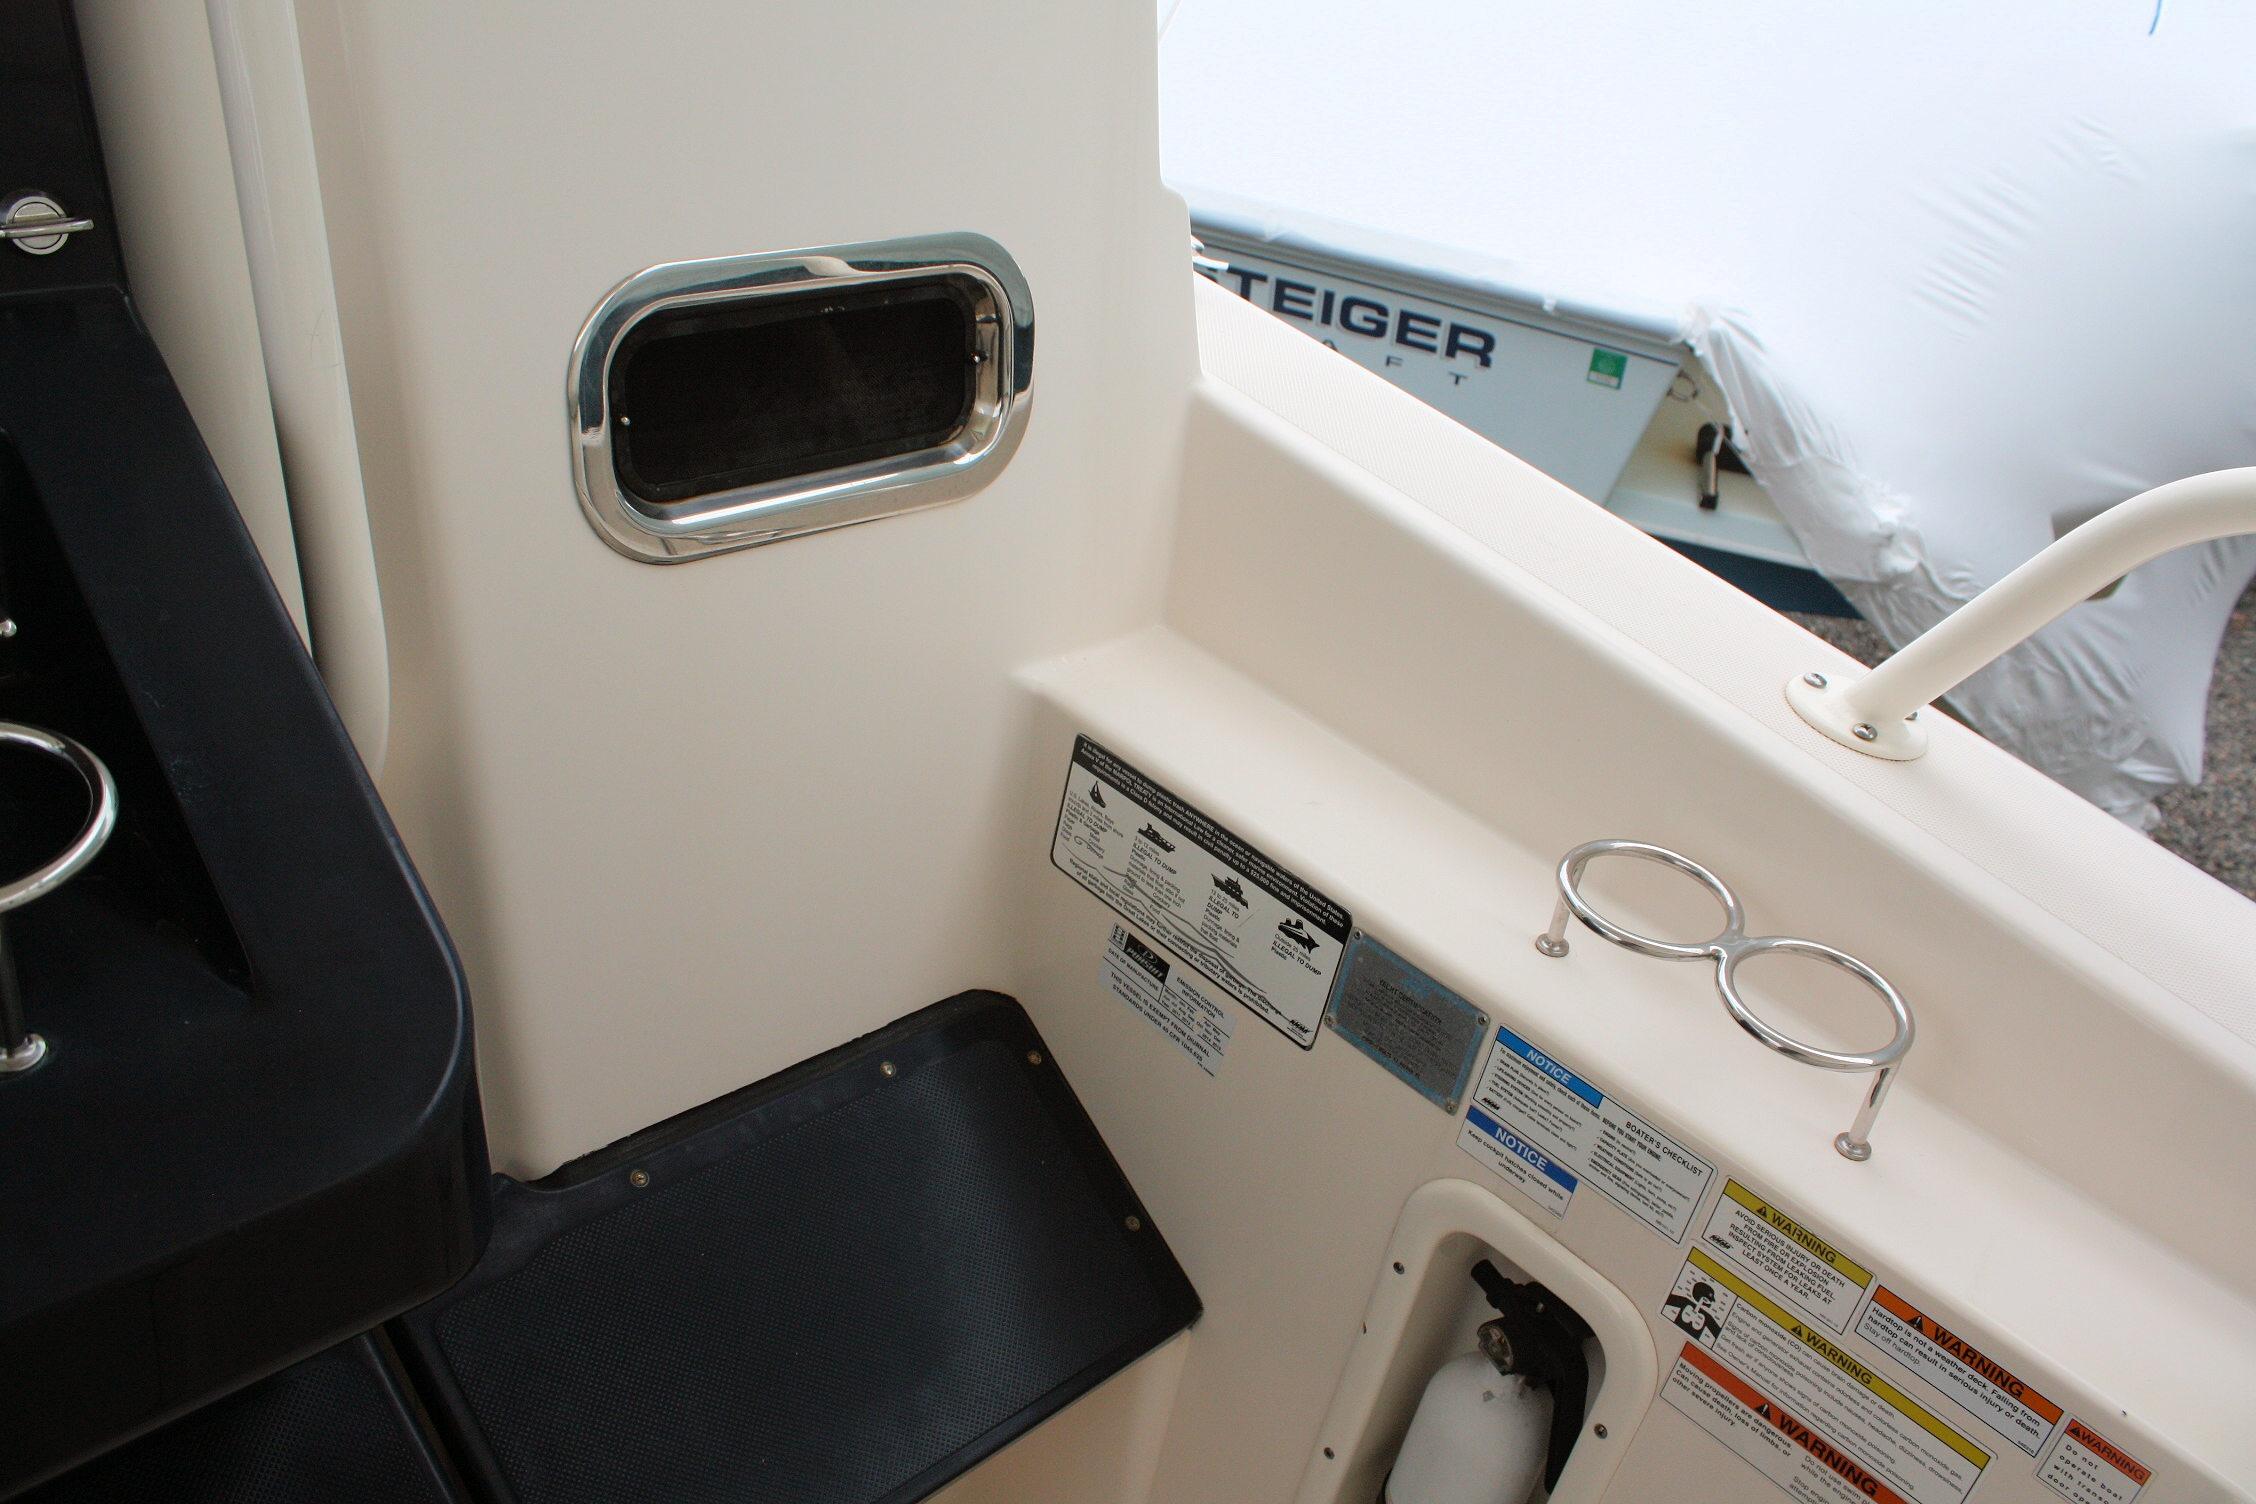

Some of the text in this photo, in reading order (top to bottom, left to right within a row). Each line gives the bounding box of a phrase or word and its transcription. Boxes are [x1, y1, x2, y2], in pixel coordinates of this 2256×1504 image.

[1192, 266, 1496, 369] TEIGER
[1154, 856, 1161, 865] TO
[1161, 862, 1176, 876] DUMP
[1206, 901, 1222, 916] DUMP
[1231, 911, 1239, 919] TO
[1299, 886, 1308, 896] the
[1308, 892, 1326, 907] United
[1272, 939, 1321, 977] ILLEGAL TO DUMP
[1526, 1048, 1572, 1085] NOTICE
[1467, 1128, 1563, 1200] Keep cockpit hatches closed while
[1494, 1126, 1547, 1171] NOTICE
[1498, 1160, 1525, 1184] underway
[1625, 1120, 1702, 1177] BOATER'S CHECKLIST
[1729, 1222, 1766, 1251] RESULTING
[1766, 1248, 1786, 1265] FROM
[1786, 1262, 1816, 1286] LEAKING
[1735, 1209, 1845, 1288] AVOID SERIOUS INJURY OR DEATH
[1743, 1223, 1829, 1286] FROM FIRE OR EXPLOSION
[1770, 1212, 1837, 1264] WARNING
[1728, 1230, 1755, 1252] INSPECT
[1756, 1250, 1783, 1272] SYSTEM
[1783, 1269, 1798, 1282] FOR
[1798, 1279, 1822, 1299] LEAKS
[1822, 1296, 1832, 1306] AT
[1741, 1249, 1763, 1267] LEAST
[1763, 1264, 1783, 1281] ONCE
[1735, 1302, 1757, 1320] Carbon
[1758, 1318, 1786, 1340] monoxide
[1787, 1339, 1801, 1351] (CO)
[1801, 1350, 1812, 1359] can
[1813, 1358, 1830, 1372] cause
[1831, 1370, 1846, 1383] brain
[1845, 1381, 1869, 1401] damage
[1862, 1322, 1881, 1338] Stay
[1880, 1334, 1891, 1345] off
[1804, 1331, 1873, 1385] WARNING
[1867, 1314, 2042, 1439] hardtop can result in serious injury or death.
[1871, 1306, 1904, 1332] Hardtop
[1904, 1328, 1912, 1337] is
[1913, 1334, 1927, 1347] not
[1934, 1349, 1966, 1375] weather
[1989, 1388, 2019, 1413] Falling
[2019, 1409, 2041, 1427] from
[1932, 1327, 2025, 1398] WARNING
[1672, 1376, 1690, 1392] other
[1691, 1391, 1713, 1410] severe
[1675, 1369, 1689, 1382] Can
[1690, 1381, 1710, 1398] cause
[1711, 1396, 1733, 1415] death,
[1734, 1412, 1749, 1426] loss
[1750, 1424, 1758, 1433] of
[1782, 1449, 1790, 1457] or
[1678, 1362, 1704, 1385] Moving
[1703, 1381, 1739, 1411] propellers
[1740, 1408, 1752, 1420] are
[1776, 1414, 1879, 1497] WARNING
[1800, 1461, 1819, 1478] while
[1819, 1475, 1832, 1488] the
[1804, 1454, 1815, 1466] Do
[1816, 1463, 1828, 1475] not
[1828, 1473, 1841, 1485] use
[2052, 1463, 2074, 1480] with
[2058, 1454, 2123, 1501] operate boat
[2065, 1444, 2098, 1469] Do not
[2080, 1431, 2145, 1480] WARNING
[2046, 1472, 2070, 1491] door
